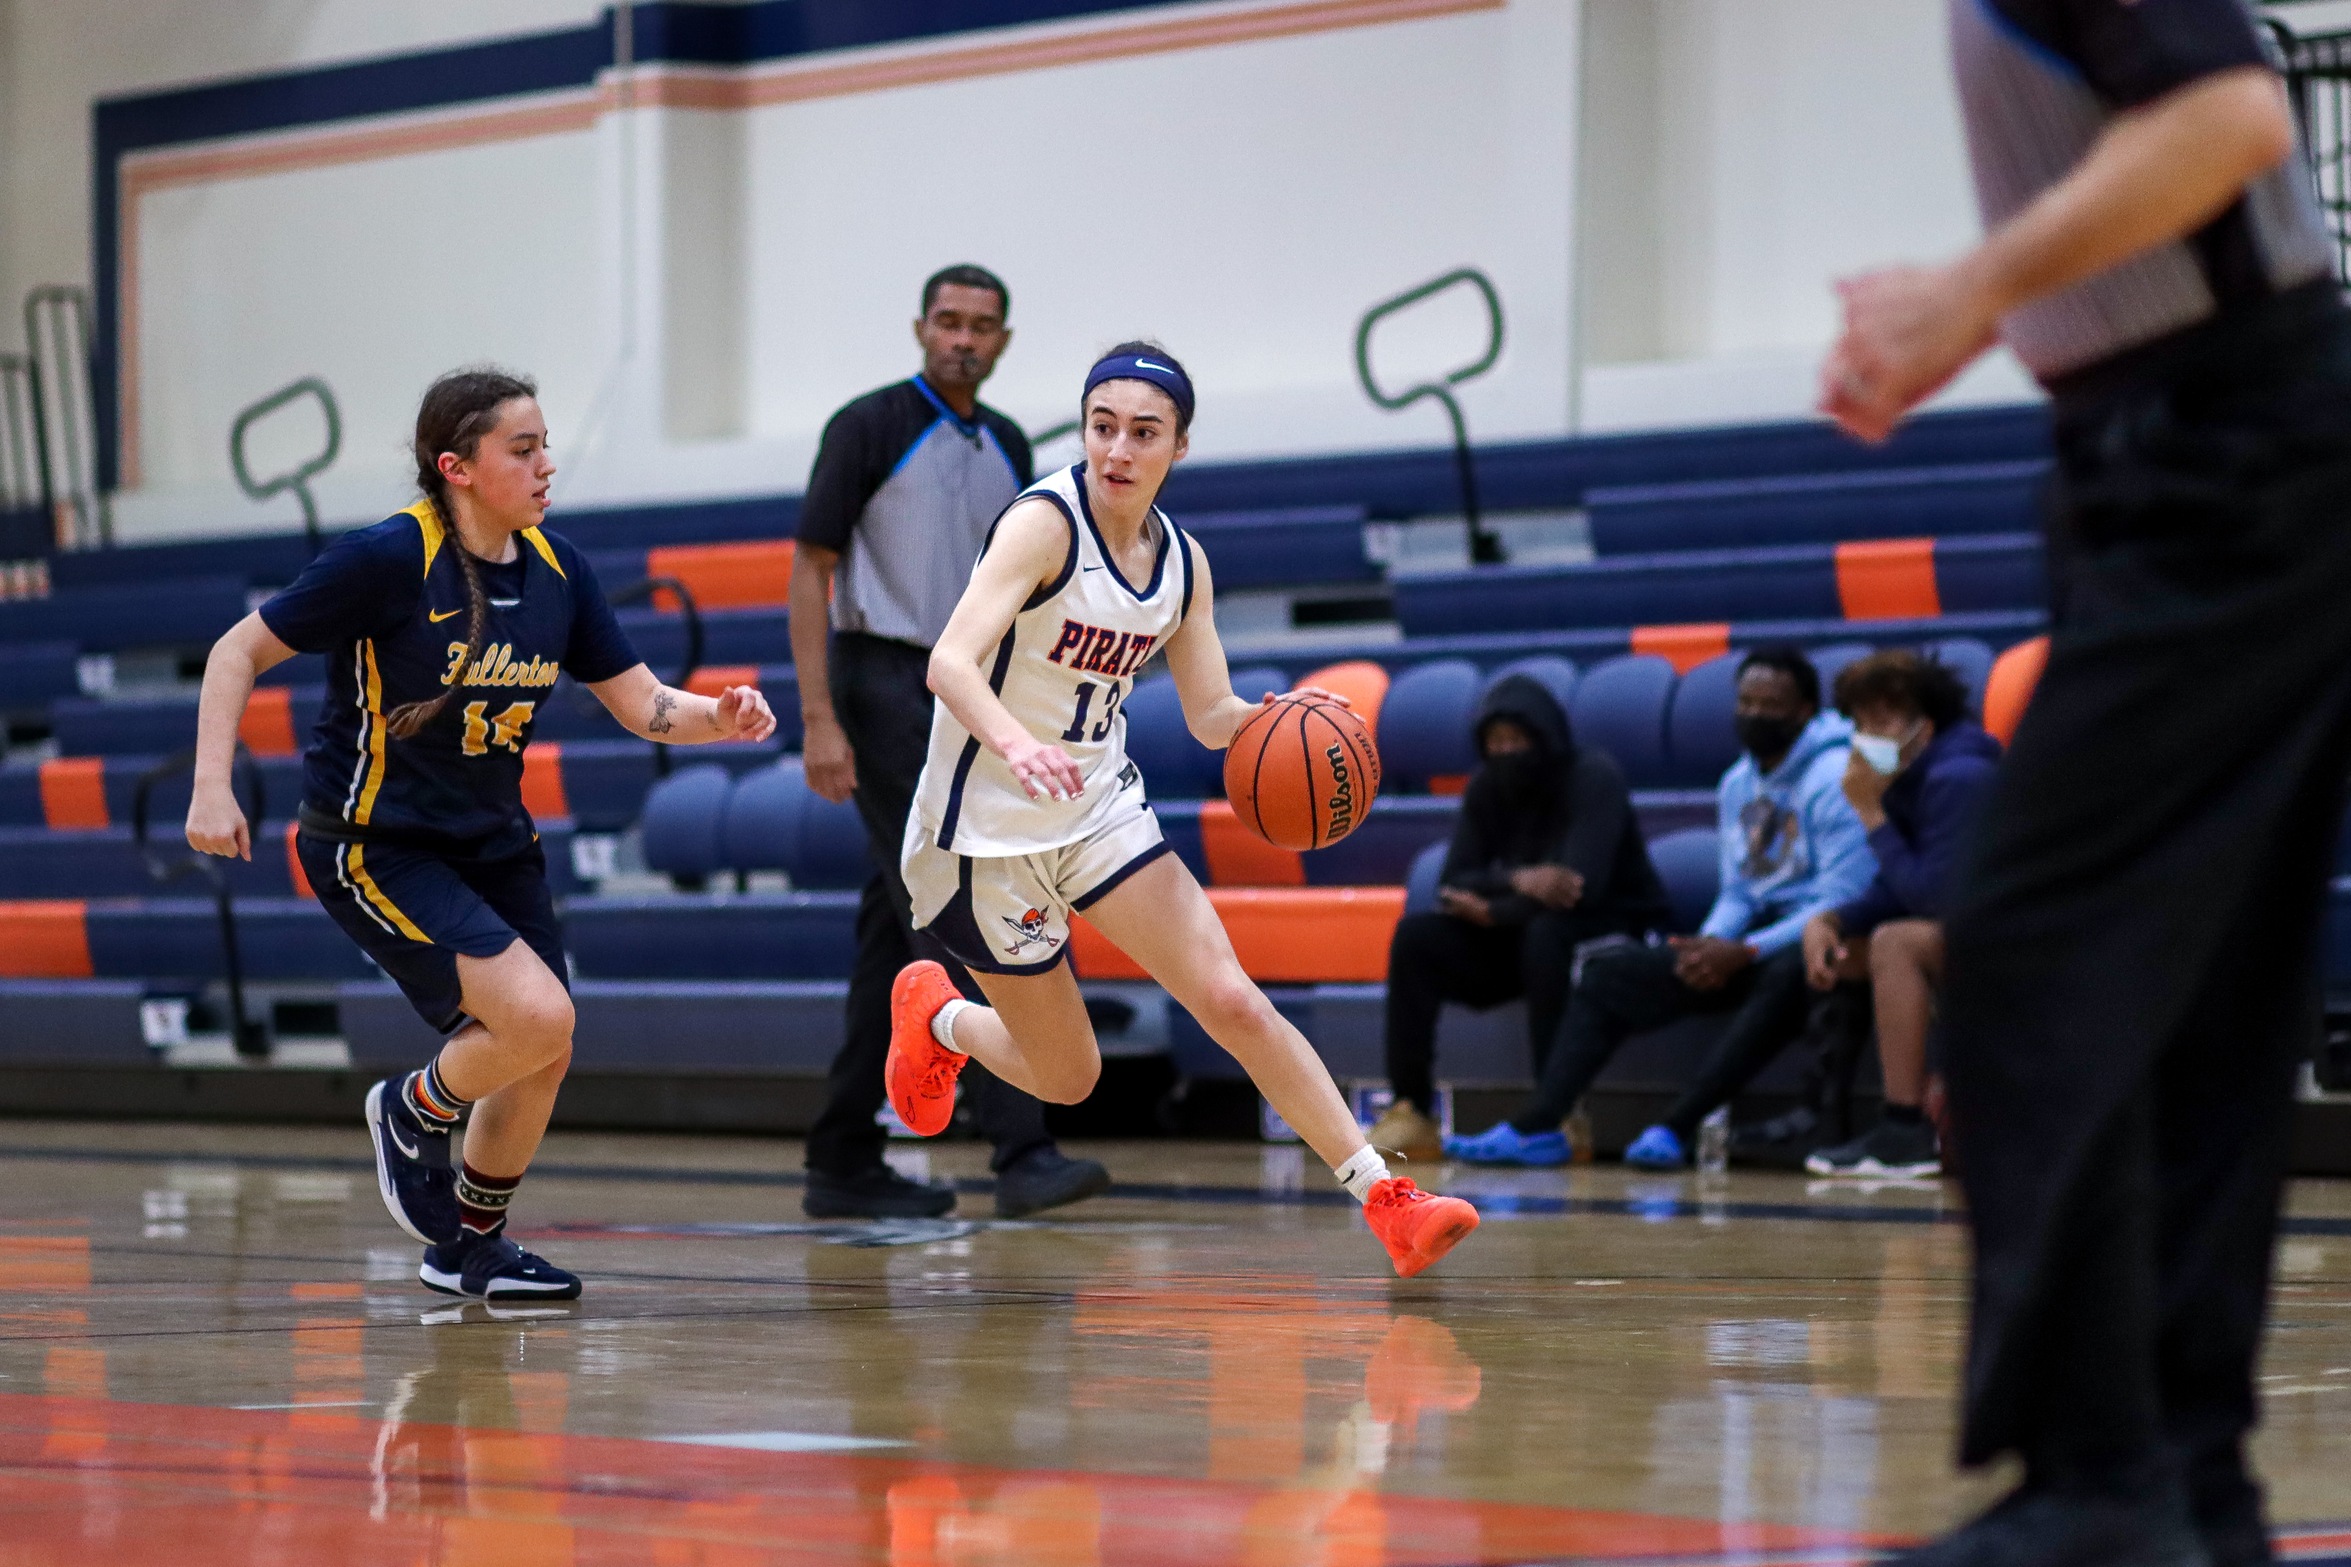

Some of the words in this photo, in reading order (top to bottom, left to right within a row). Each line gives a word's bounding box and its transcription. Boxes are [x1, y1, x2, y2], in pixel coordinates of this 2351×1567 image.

[441, 641, 559, 688] Fullerton
[1061, 680, 1121, 743] 13
[1325, 742, 1354, 842] Wilson
